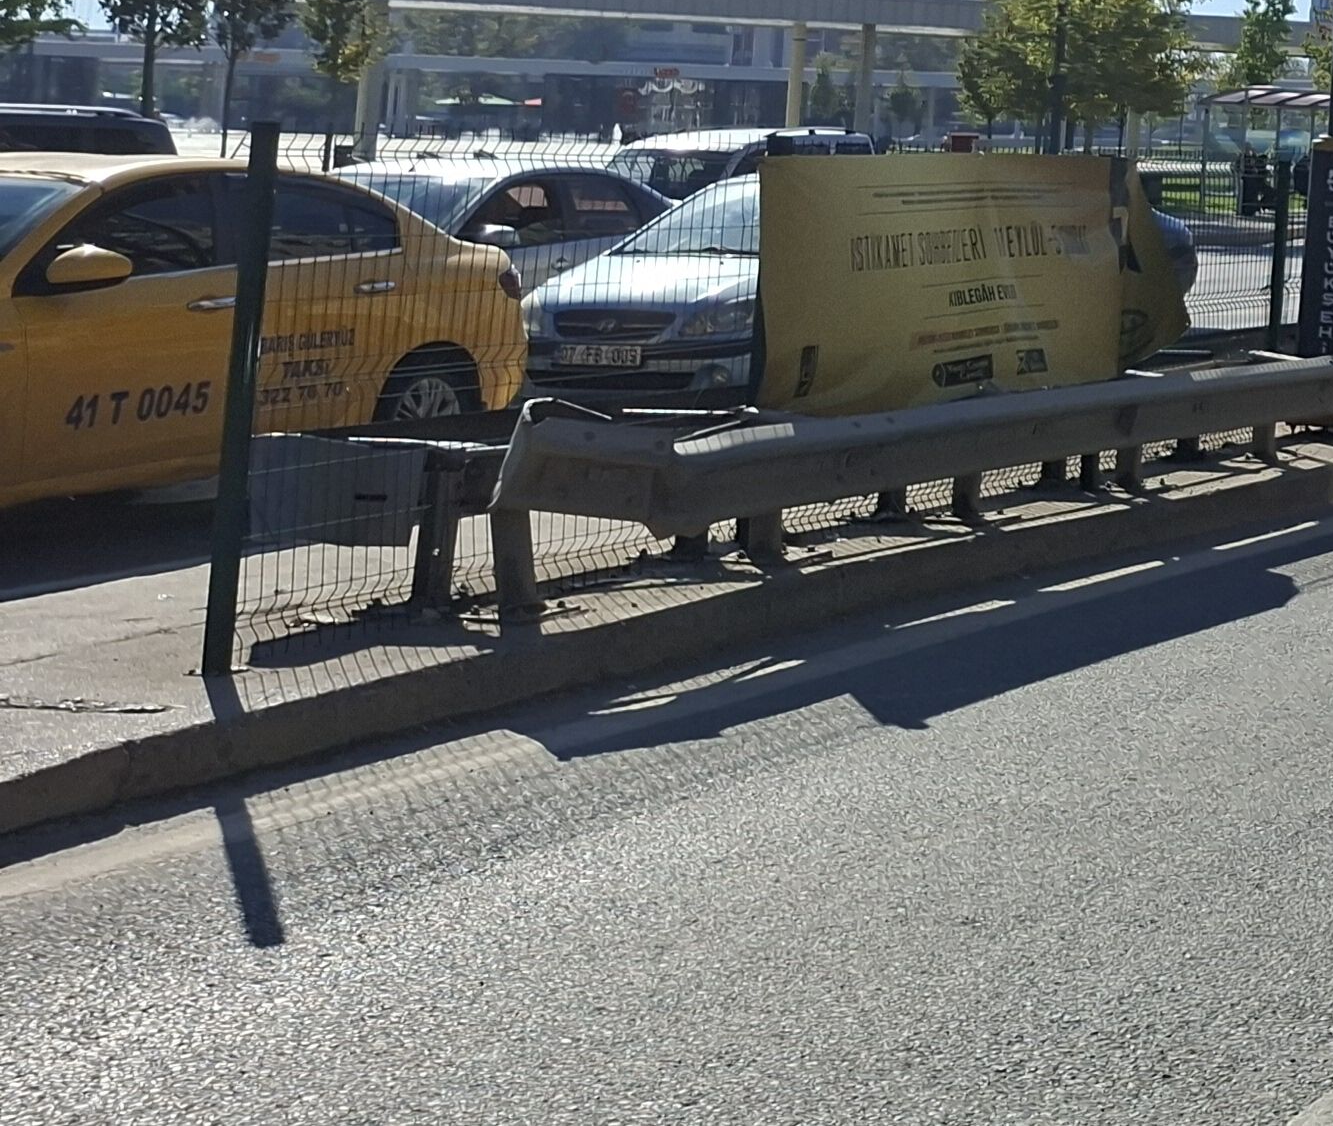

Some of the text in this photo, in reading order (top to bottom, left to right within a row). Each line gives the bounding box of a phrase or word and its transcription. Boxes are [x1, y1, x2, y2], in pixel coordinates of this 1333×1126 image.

[66, 381, 211, 430] 41 T 0045
